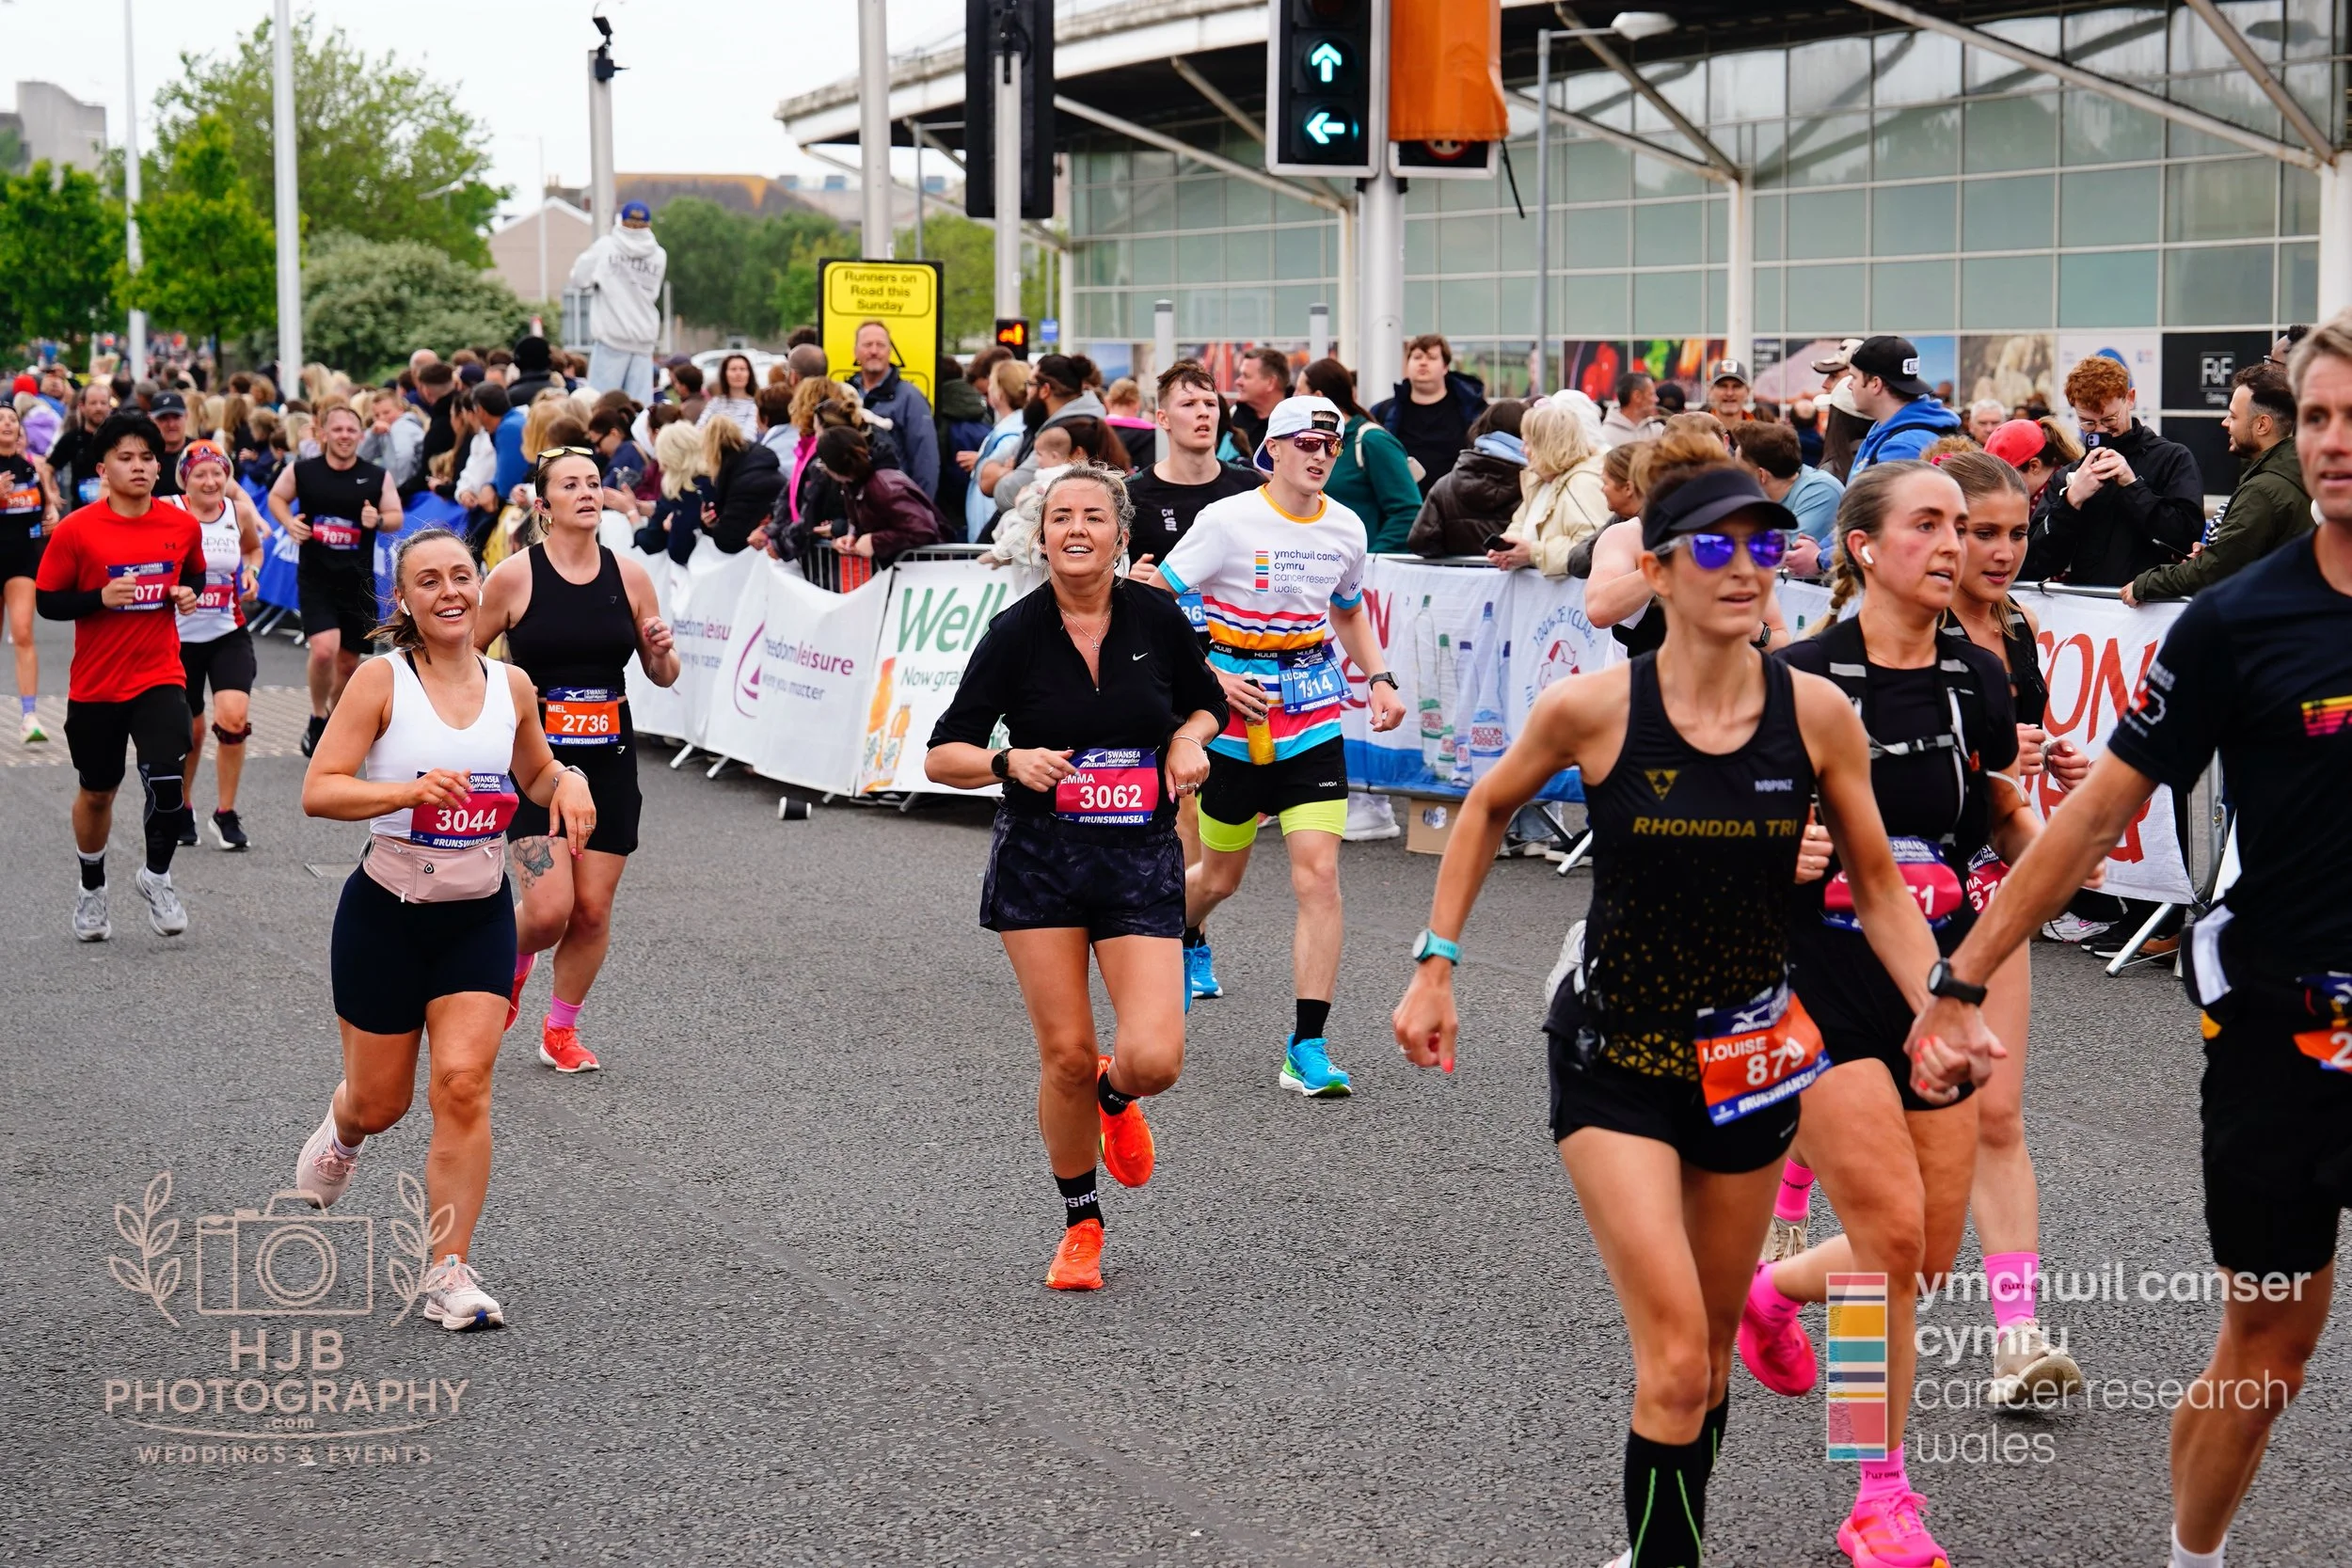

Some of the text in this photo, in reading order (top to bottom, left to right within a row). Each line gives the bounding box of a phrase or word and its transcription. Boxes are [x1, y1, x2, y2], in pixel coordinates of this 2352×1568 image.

[844, 270, 917, 283] Runners on
[850, 284, 911, 297] Road this
[856, 299, 905, 313] Sunday
[1274, 549, 1315, 560] ymchwil
[1274, 562, 1305, 572] cymru
[1274, 573, 1305, 582] cancer
[1274, 584, 1304, 594] wales
[900, 666, 932, 687] Now
[1281, 671, 1310, 682] LUCAS
[788, 678, 826, 701] matter
[1298, 673, 1334, 699] 1914
[548, 705, 567, 714] MEL
[562, 714, 610, 734] 2736
[561, 736, 609, 745] #RUNSWANSEA
[1107, 751, 1141, 759] SWANSEA
[470, 775, 500, 784] SWANSEA
[1060, 773, 1096, 784] EMMA
[1079, 784, 1143, 809] 3062
[435, 808, 498, 832] 3044
[1078, 815, 1144, 825] #RUNSWANSEA
[1632, 816, 1798, 836] RHONDDA TRI
[432, 836, 492, 848] #RUNSWANSEA
[1702, 1036, 1768, 1063] LOUISE
[1746, 1037, 1806, 1086] 879
